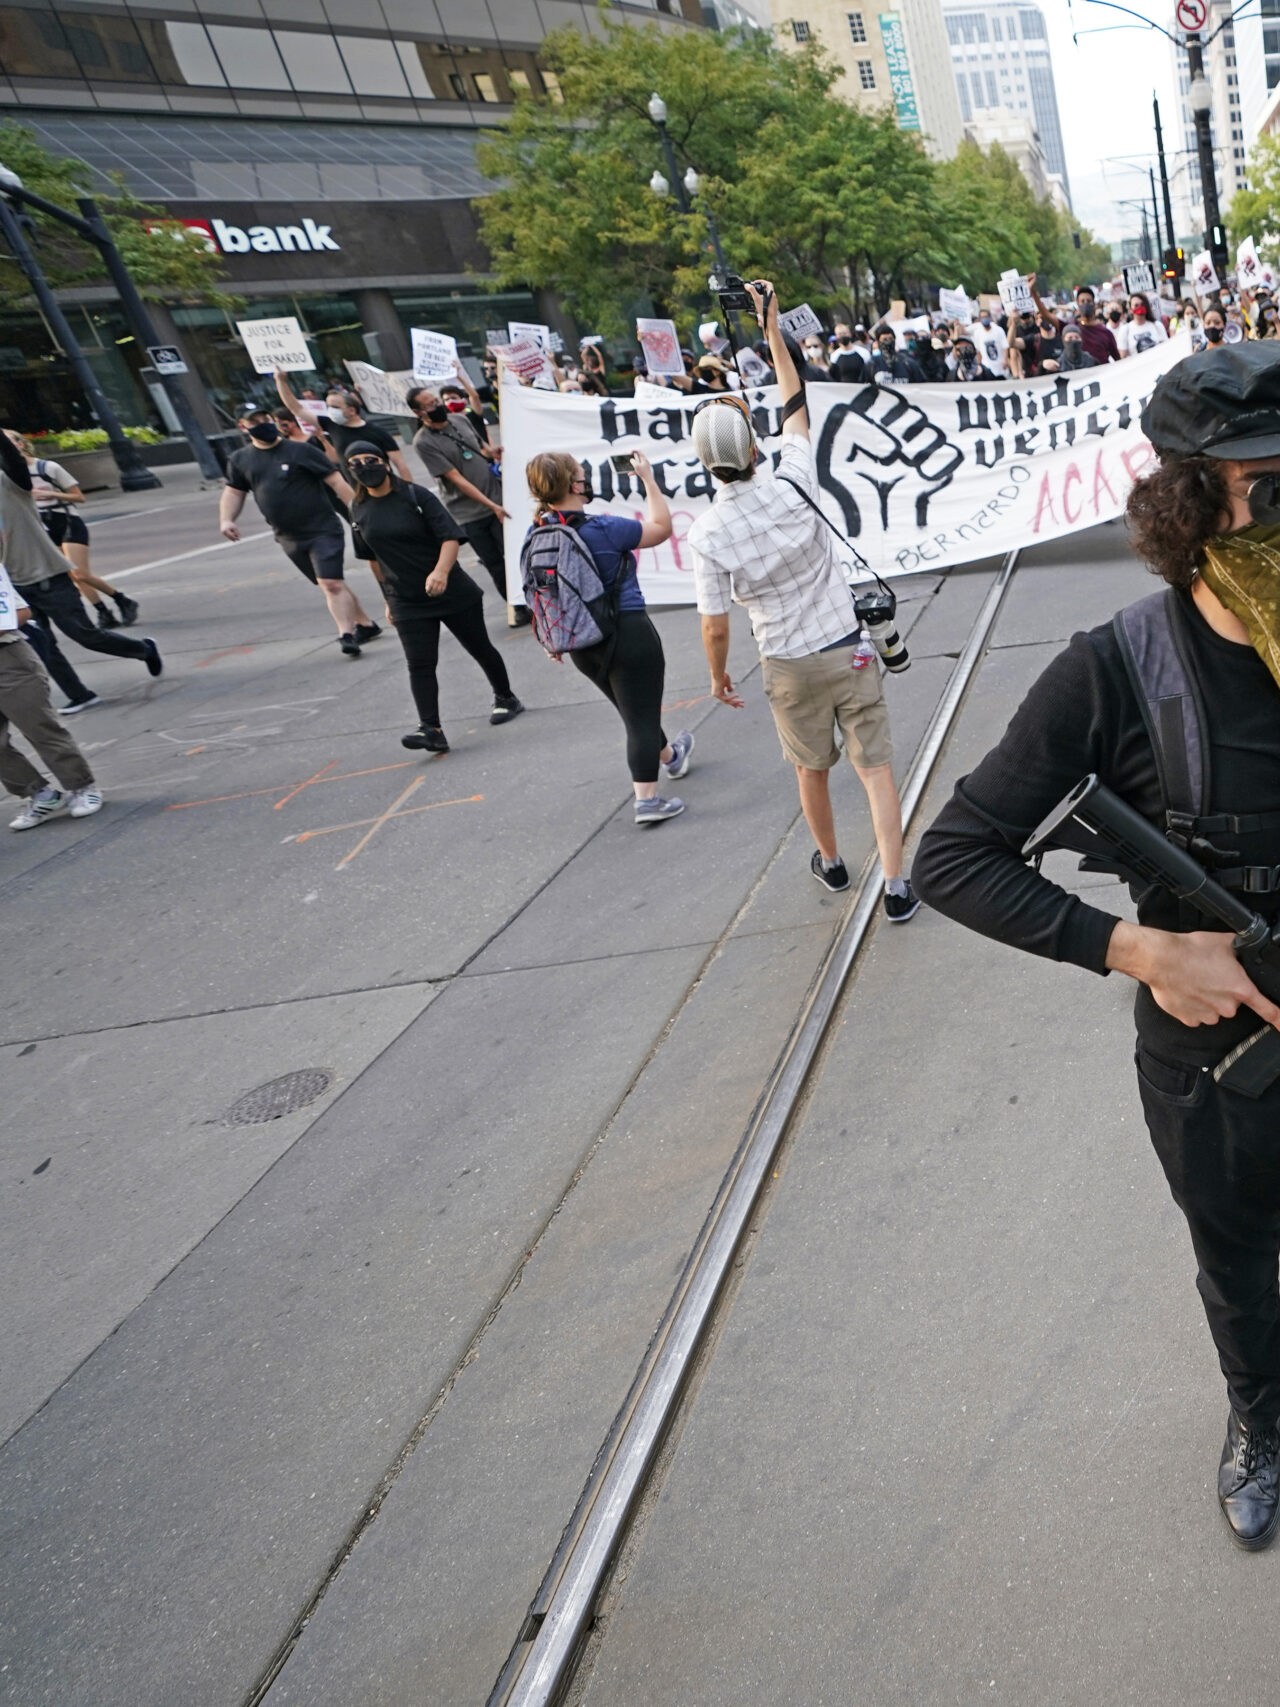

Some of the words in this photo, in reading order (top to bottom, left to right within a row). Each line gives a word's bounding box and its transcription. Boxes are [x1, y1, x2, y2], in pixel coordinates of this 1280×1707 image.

[882, 29, 899, 71] LEASE
[892, 74, 905, 104] FOR
[956, 376, 1101, 432] unido
